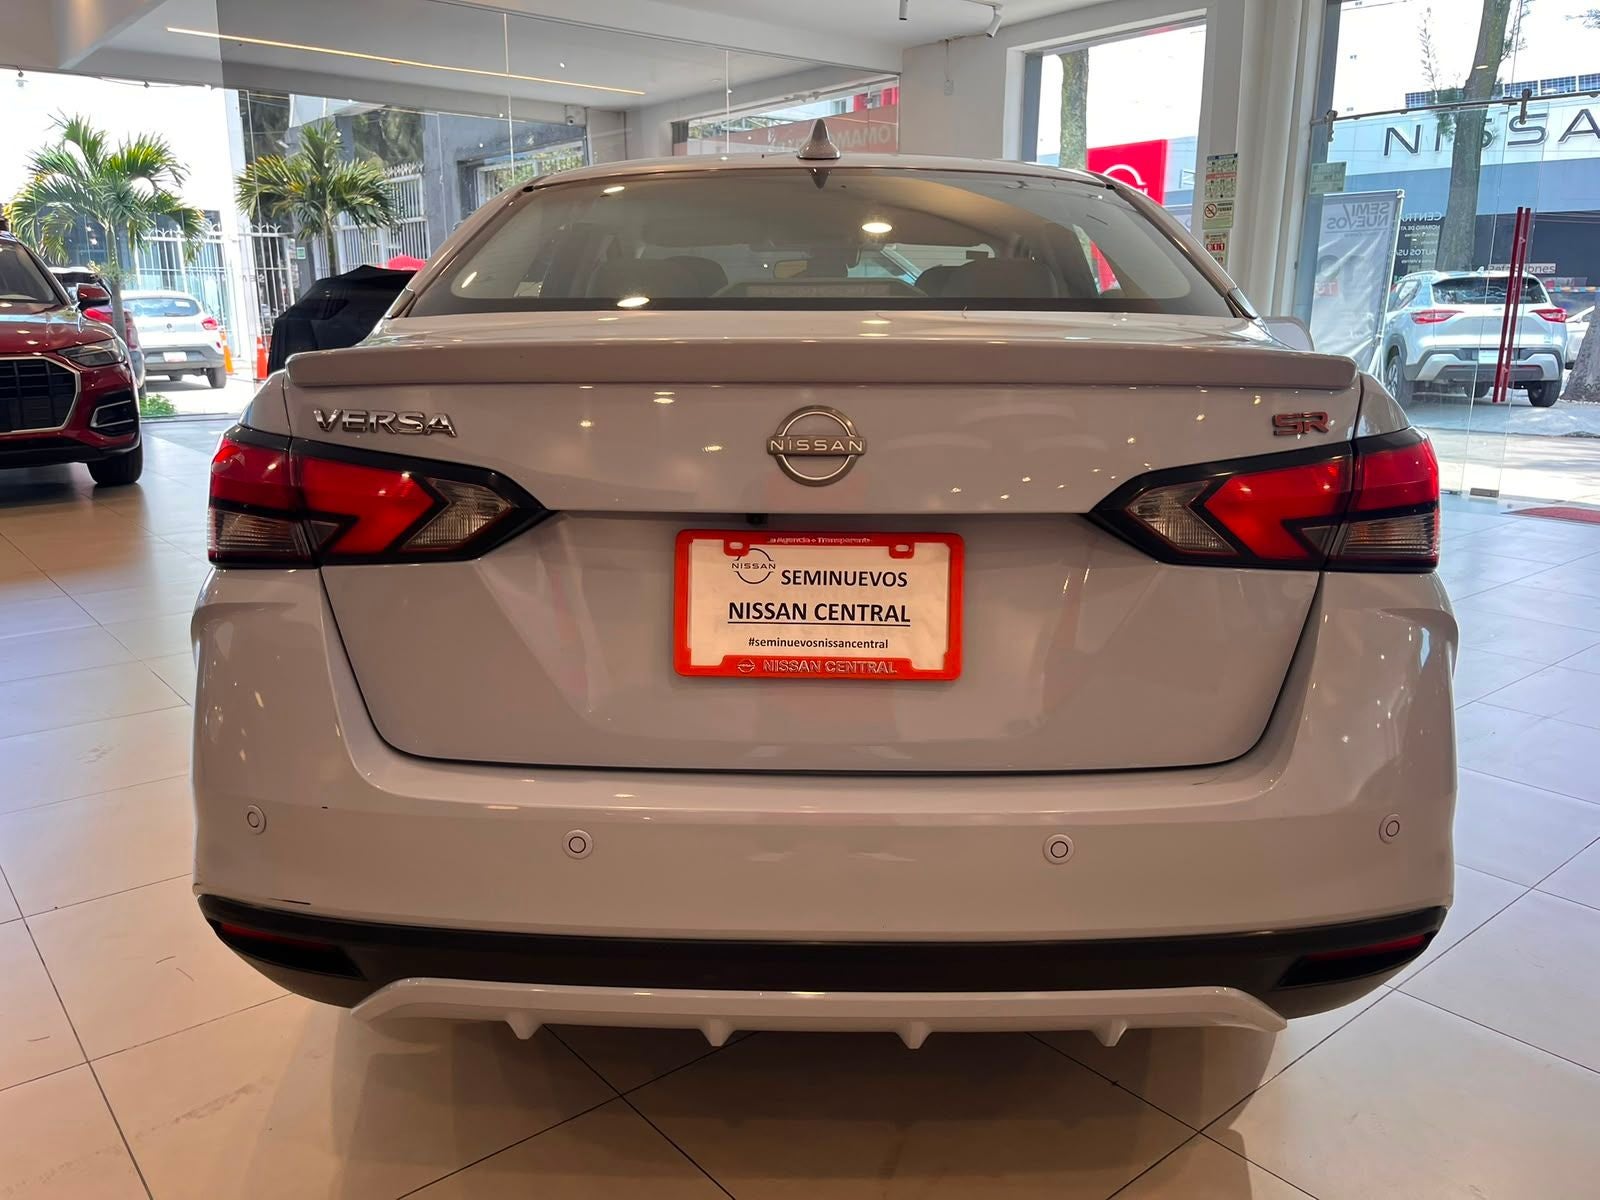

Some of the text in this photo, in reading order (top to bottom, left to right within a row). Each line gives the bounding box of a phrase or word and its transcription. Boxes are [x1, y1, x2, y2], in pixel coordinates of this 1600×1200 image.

[1384, 108, 1600, 157] NISA
[312, 408, 457, 437] VERSA
[1272, 411, 1330, 436] SR
[769, 438, 863, 452] NISSAN
[732, 561, 776, 570] NISSAN
[781, 569, 908, 587] SEMINUEVOS
[728, 602, 910, 622] NISSAN CENTRAL
[748, 636, 889, 649] #seminuevosnissancentral
[762, 659, 821, 672] NISSAN
[825, 660, 897, 674] CENTRAL
